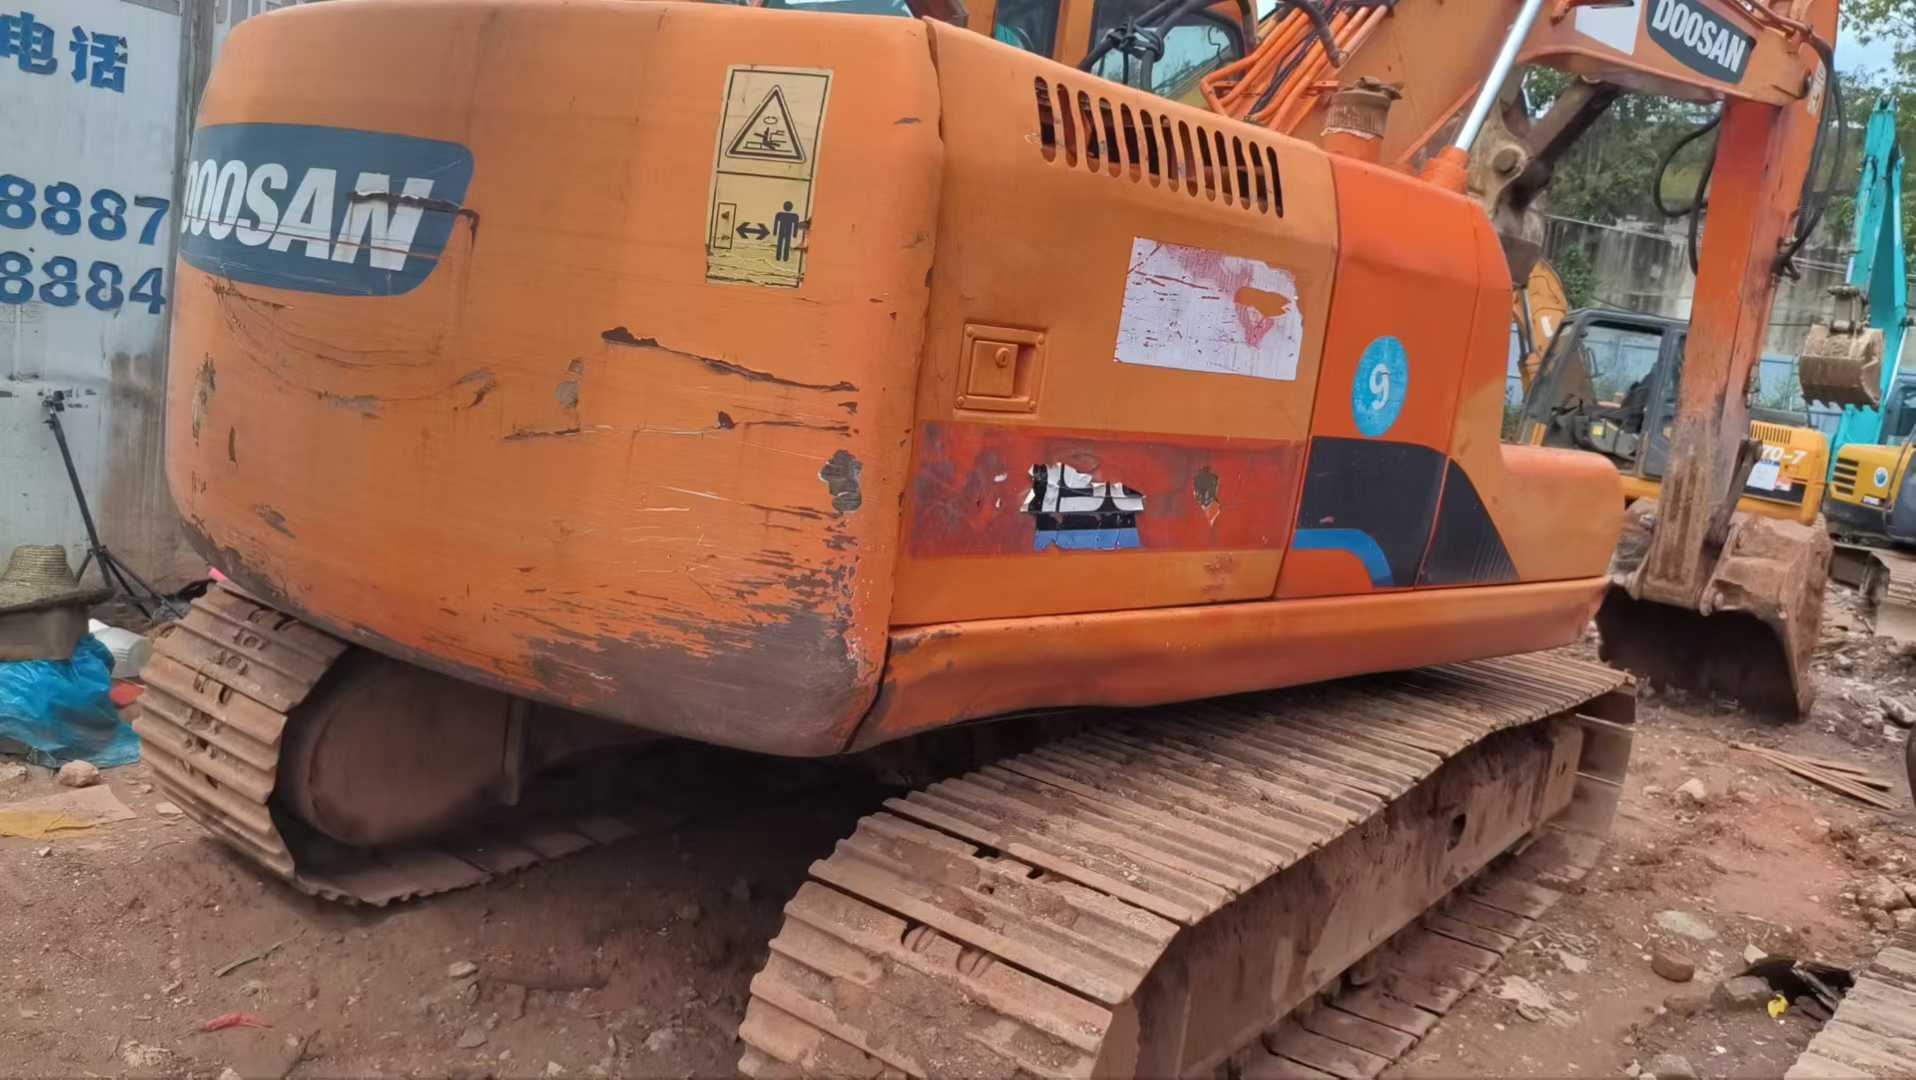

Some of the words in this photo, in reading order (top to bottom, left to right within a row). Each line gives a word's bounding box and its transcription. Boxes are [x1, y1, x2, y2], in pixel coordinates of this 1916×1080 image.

[0, 11, 128, 93] 电话
[1652, 0, 1746, 73] DOOSAN
[0, 174, 170, 245] 8887
[0, 251, 166, 314] 8884
